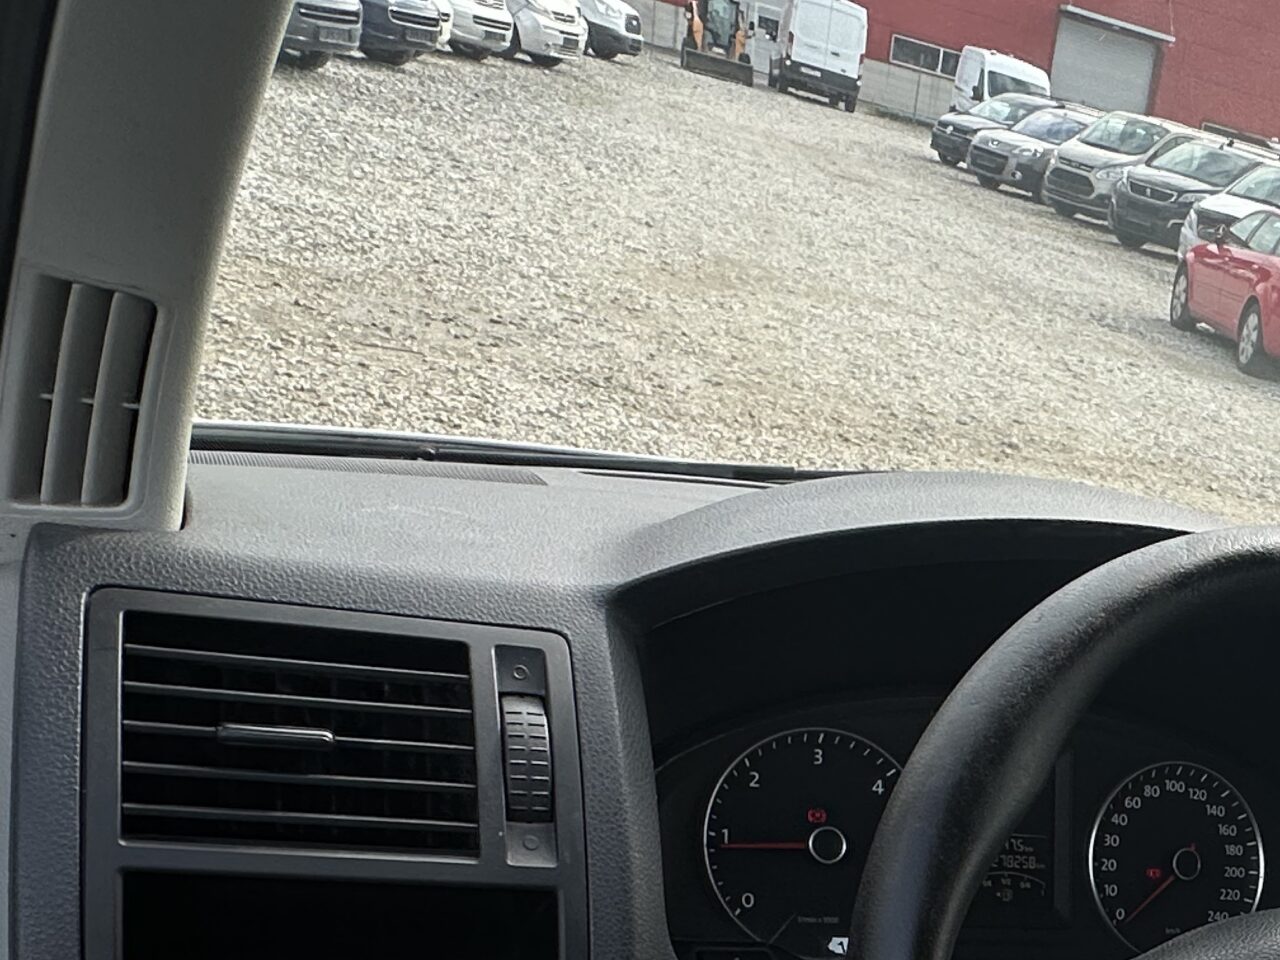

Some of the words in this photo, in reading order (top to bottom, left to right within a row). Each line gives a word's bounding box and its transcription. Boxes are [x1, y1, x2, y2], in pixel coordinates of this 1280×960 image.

[813, 749, 823, 764] 3
[749, 771, 760, 787] 2
[1164, 779, 1185, 792] 100
[872, 779, 884, 795] 4
[1143, 785, 1160, 797] 80
[1188, 788, 1207, 801] 120
[1124, 796, 1141, 809] 60
[1205, 804, 1225, 817] 140
[1111, 813, 1128, 826] 40
[721, 829, 729, 844] 1
[1217, 823, 1237, 837] 160
[1103, 834, 1120, 847] 30
[1224, 844, 1244, 856] 180
[1101, 858, 1117, 871] 20
[1224, 867, 1245, 878] 200
[1104, 884, 1118, 897] 10
[1219, 888, 1241, 901] 220
[741, 893, 754, 908] 0
[1115, 908, 1125, 920] 0
[1207, 911, 1229, 922] 240
